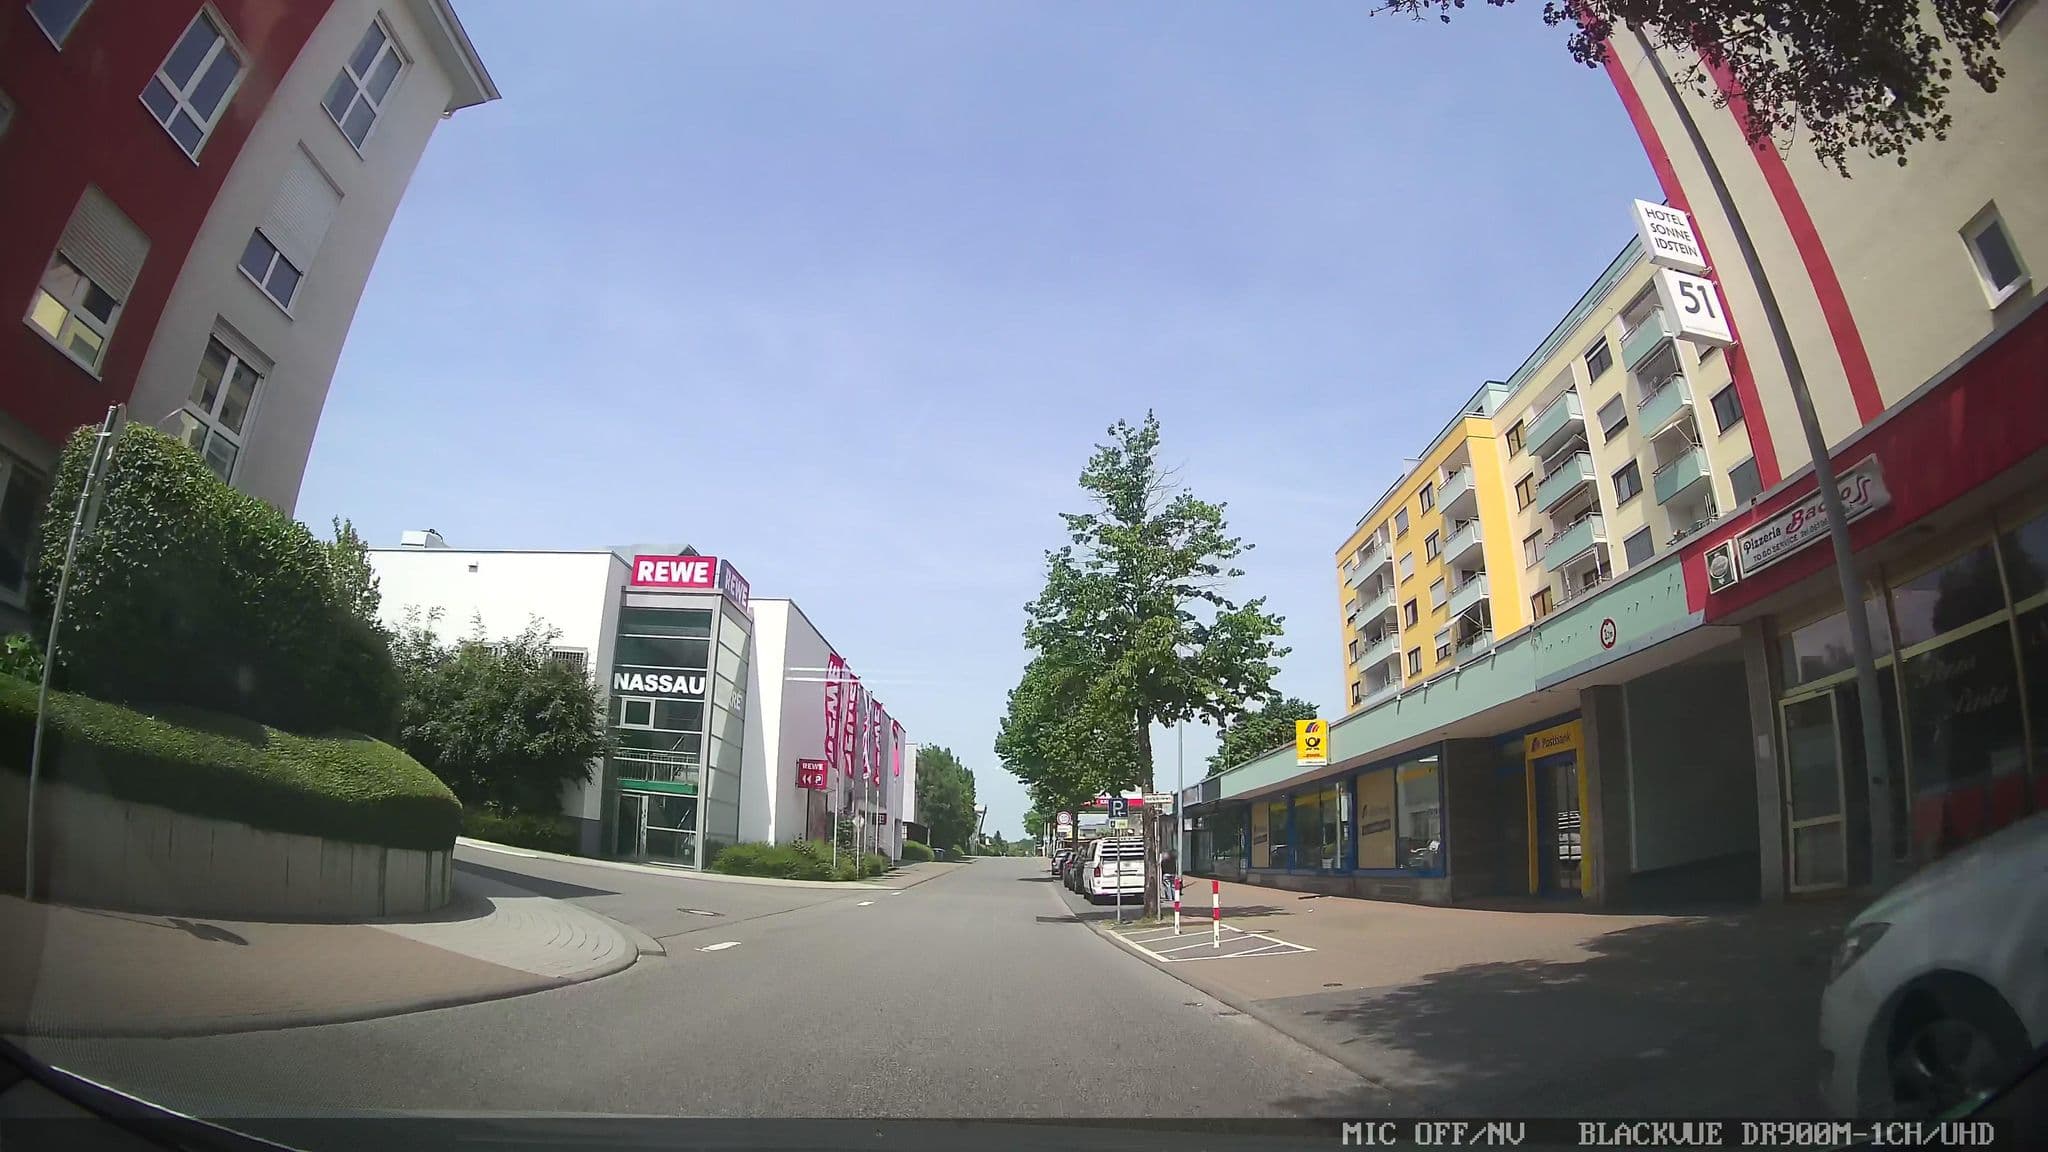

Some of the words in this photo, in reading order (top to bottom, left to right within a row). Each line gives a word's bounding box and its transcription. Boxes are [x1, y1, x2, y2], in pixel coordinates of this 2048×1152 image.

[1645, 208, 1684, 226] HOTEL
[1651, 223, 1691, 242] SONNE
[1655, 237, 1698, 257] IDSTEIN
[1679, 280, 1716, 319] 51
[1743, 527, 1782, 554] Pizzeria
[637, 560, 709, 583] REWE
[725, 567, 749, 606] REWE
[613, 672, 706, 695] NASSAU
[1542, 731, 1572, 749] Postbank
[801, 762, 824, 771] REWE
[1113, 801, 1124, 816] P
